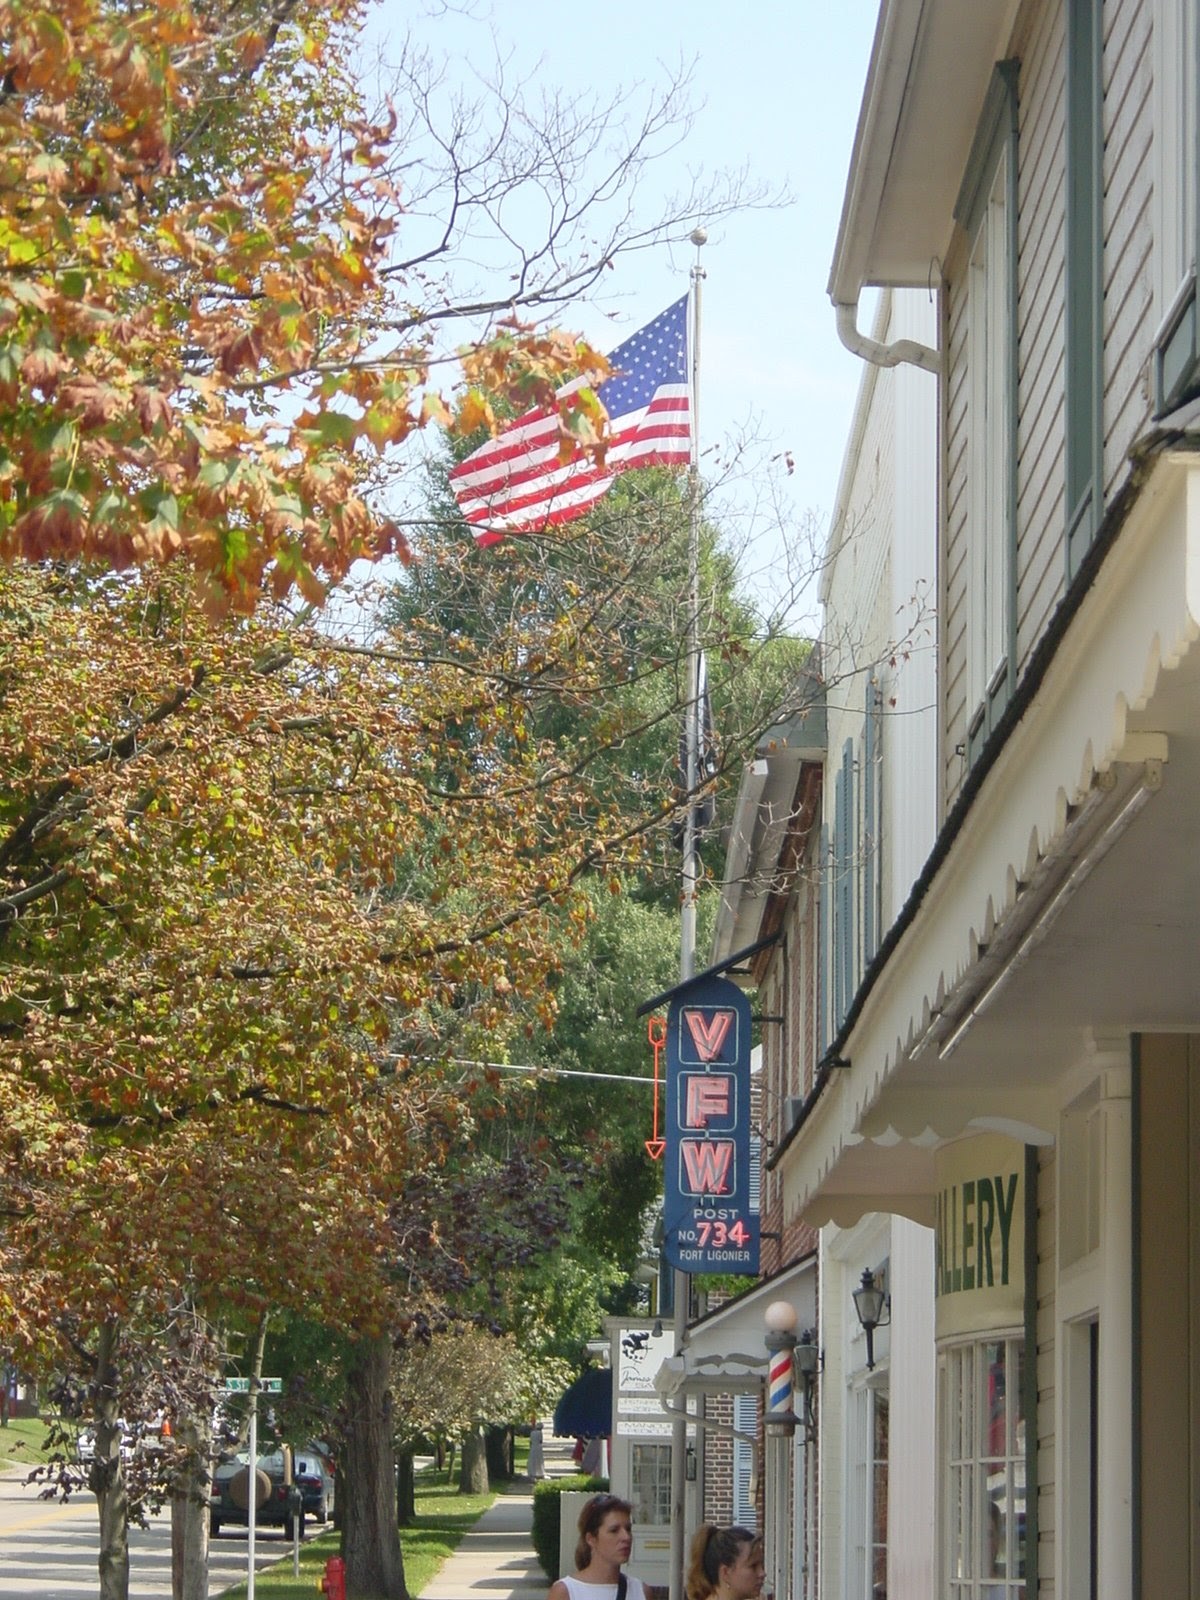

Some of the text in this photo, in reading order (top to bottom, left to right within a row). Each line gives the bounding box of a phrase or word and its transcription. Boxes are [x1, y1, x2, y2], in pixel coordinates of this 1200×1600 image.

[693, 1208, 739, 1220] POST
[678, 1220, 750, 1248] NO. 734
[679, 1250, 750, 1261] FORT LIGONIER
